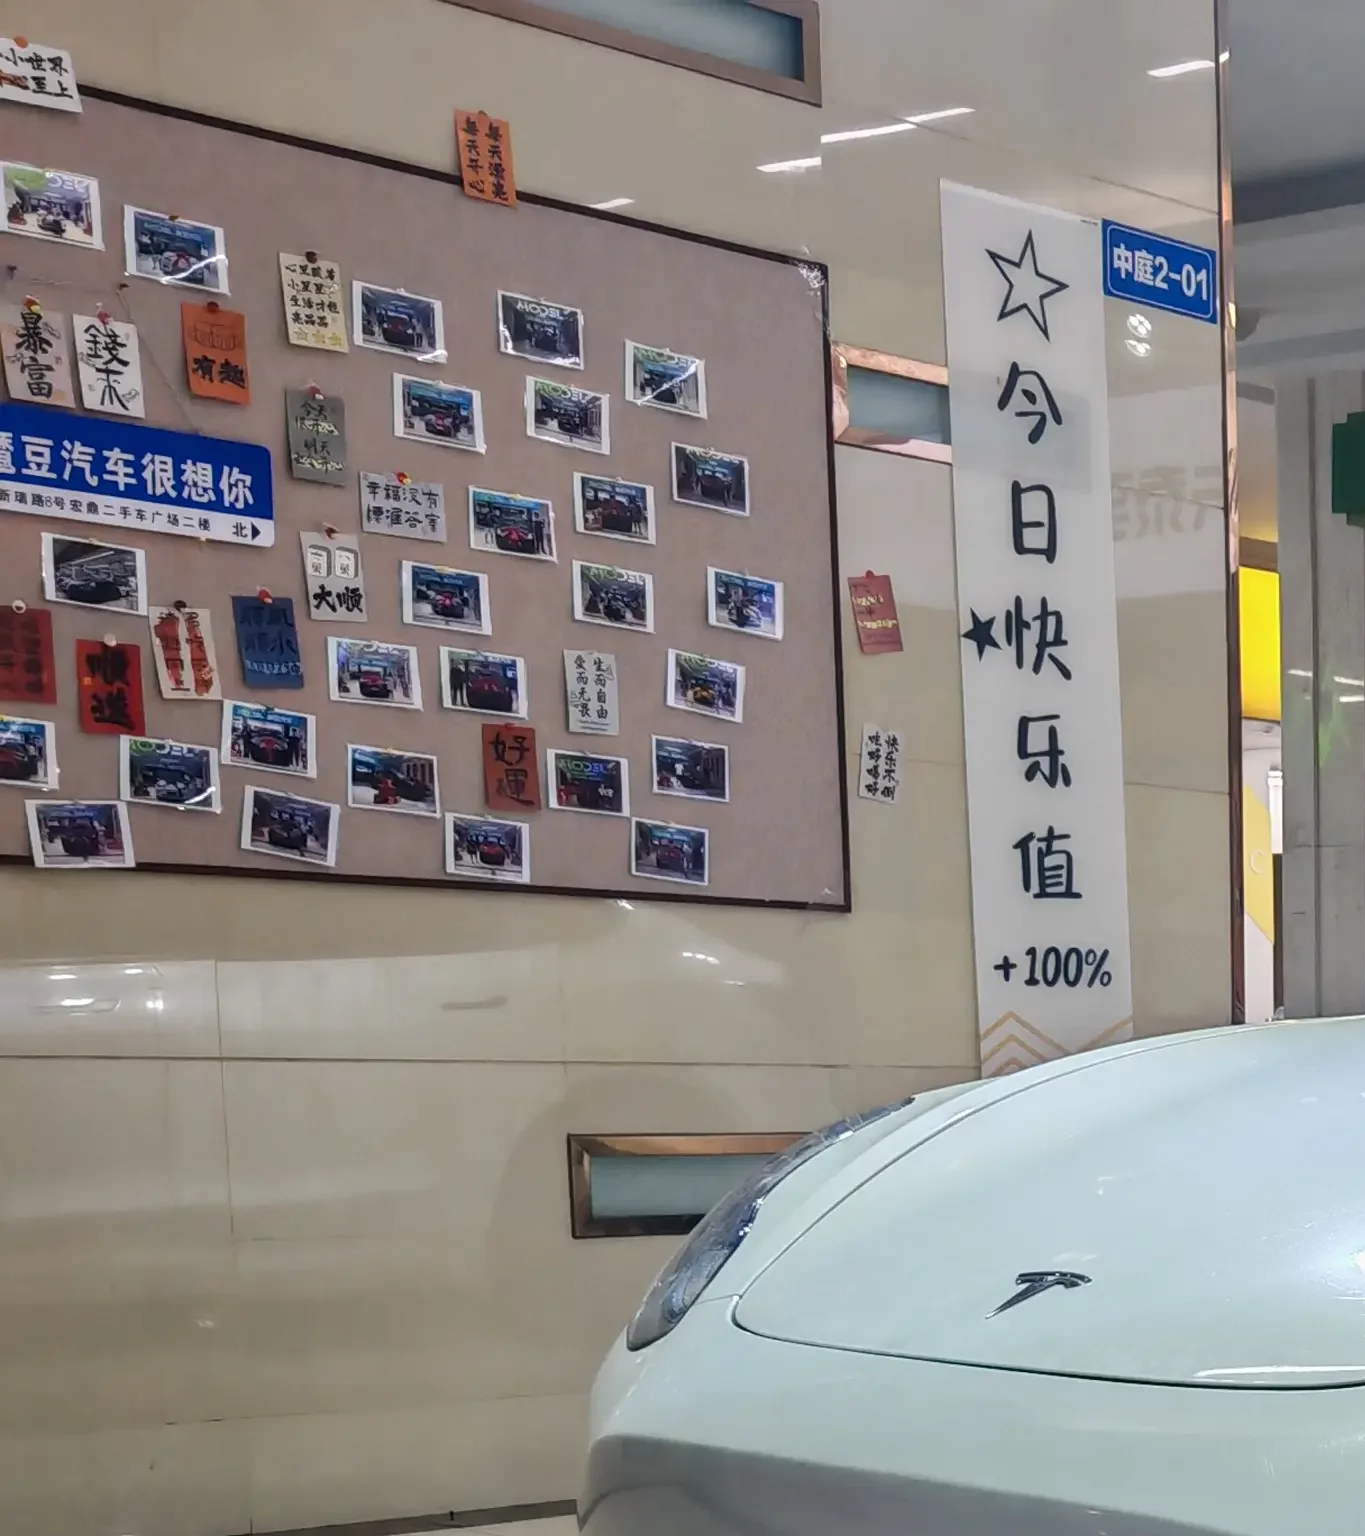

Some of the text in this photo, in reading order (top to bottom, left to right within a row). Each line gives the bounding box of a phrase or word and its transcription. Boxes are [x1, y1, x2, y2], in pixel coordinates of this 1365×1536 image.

[1111, 241, 1209, 301] 中庭2-01
[192, 354, 246, 389] 有趣
[232, 521, 248, 539] 北
[312, 583, 364, 614] 大顺
[997, 360, 1084, 900] 今日快乐值
[992, 945, 1113, 989] +100%
